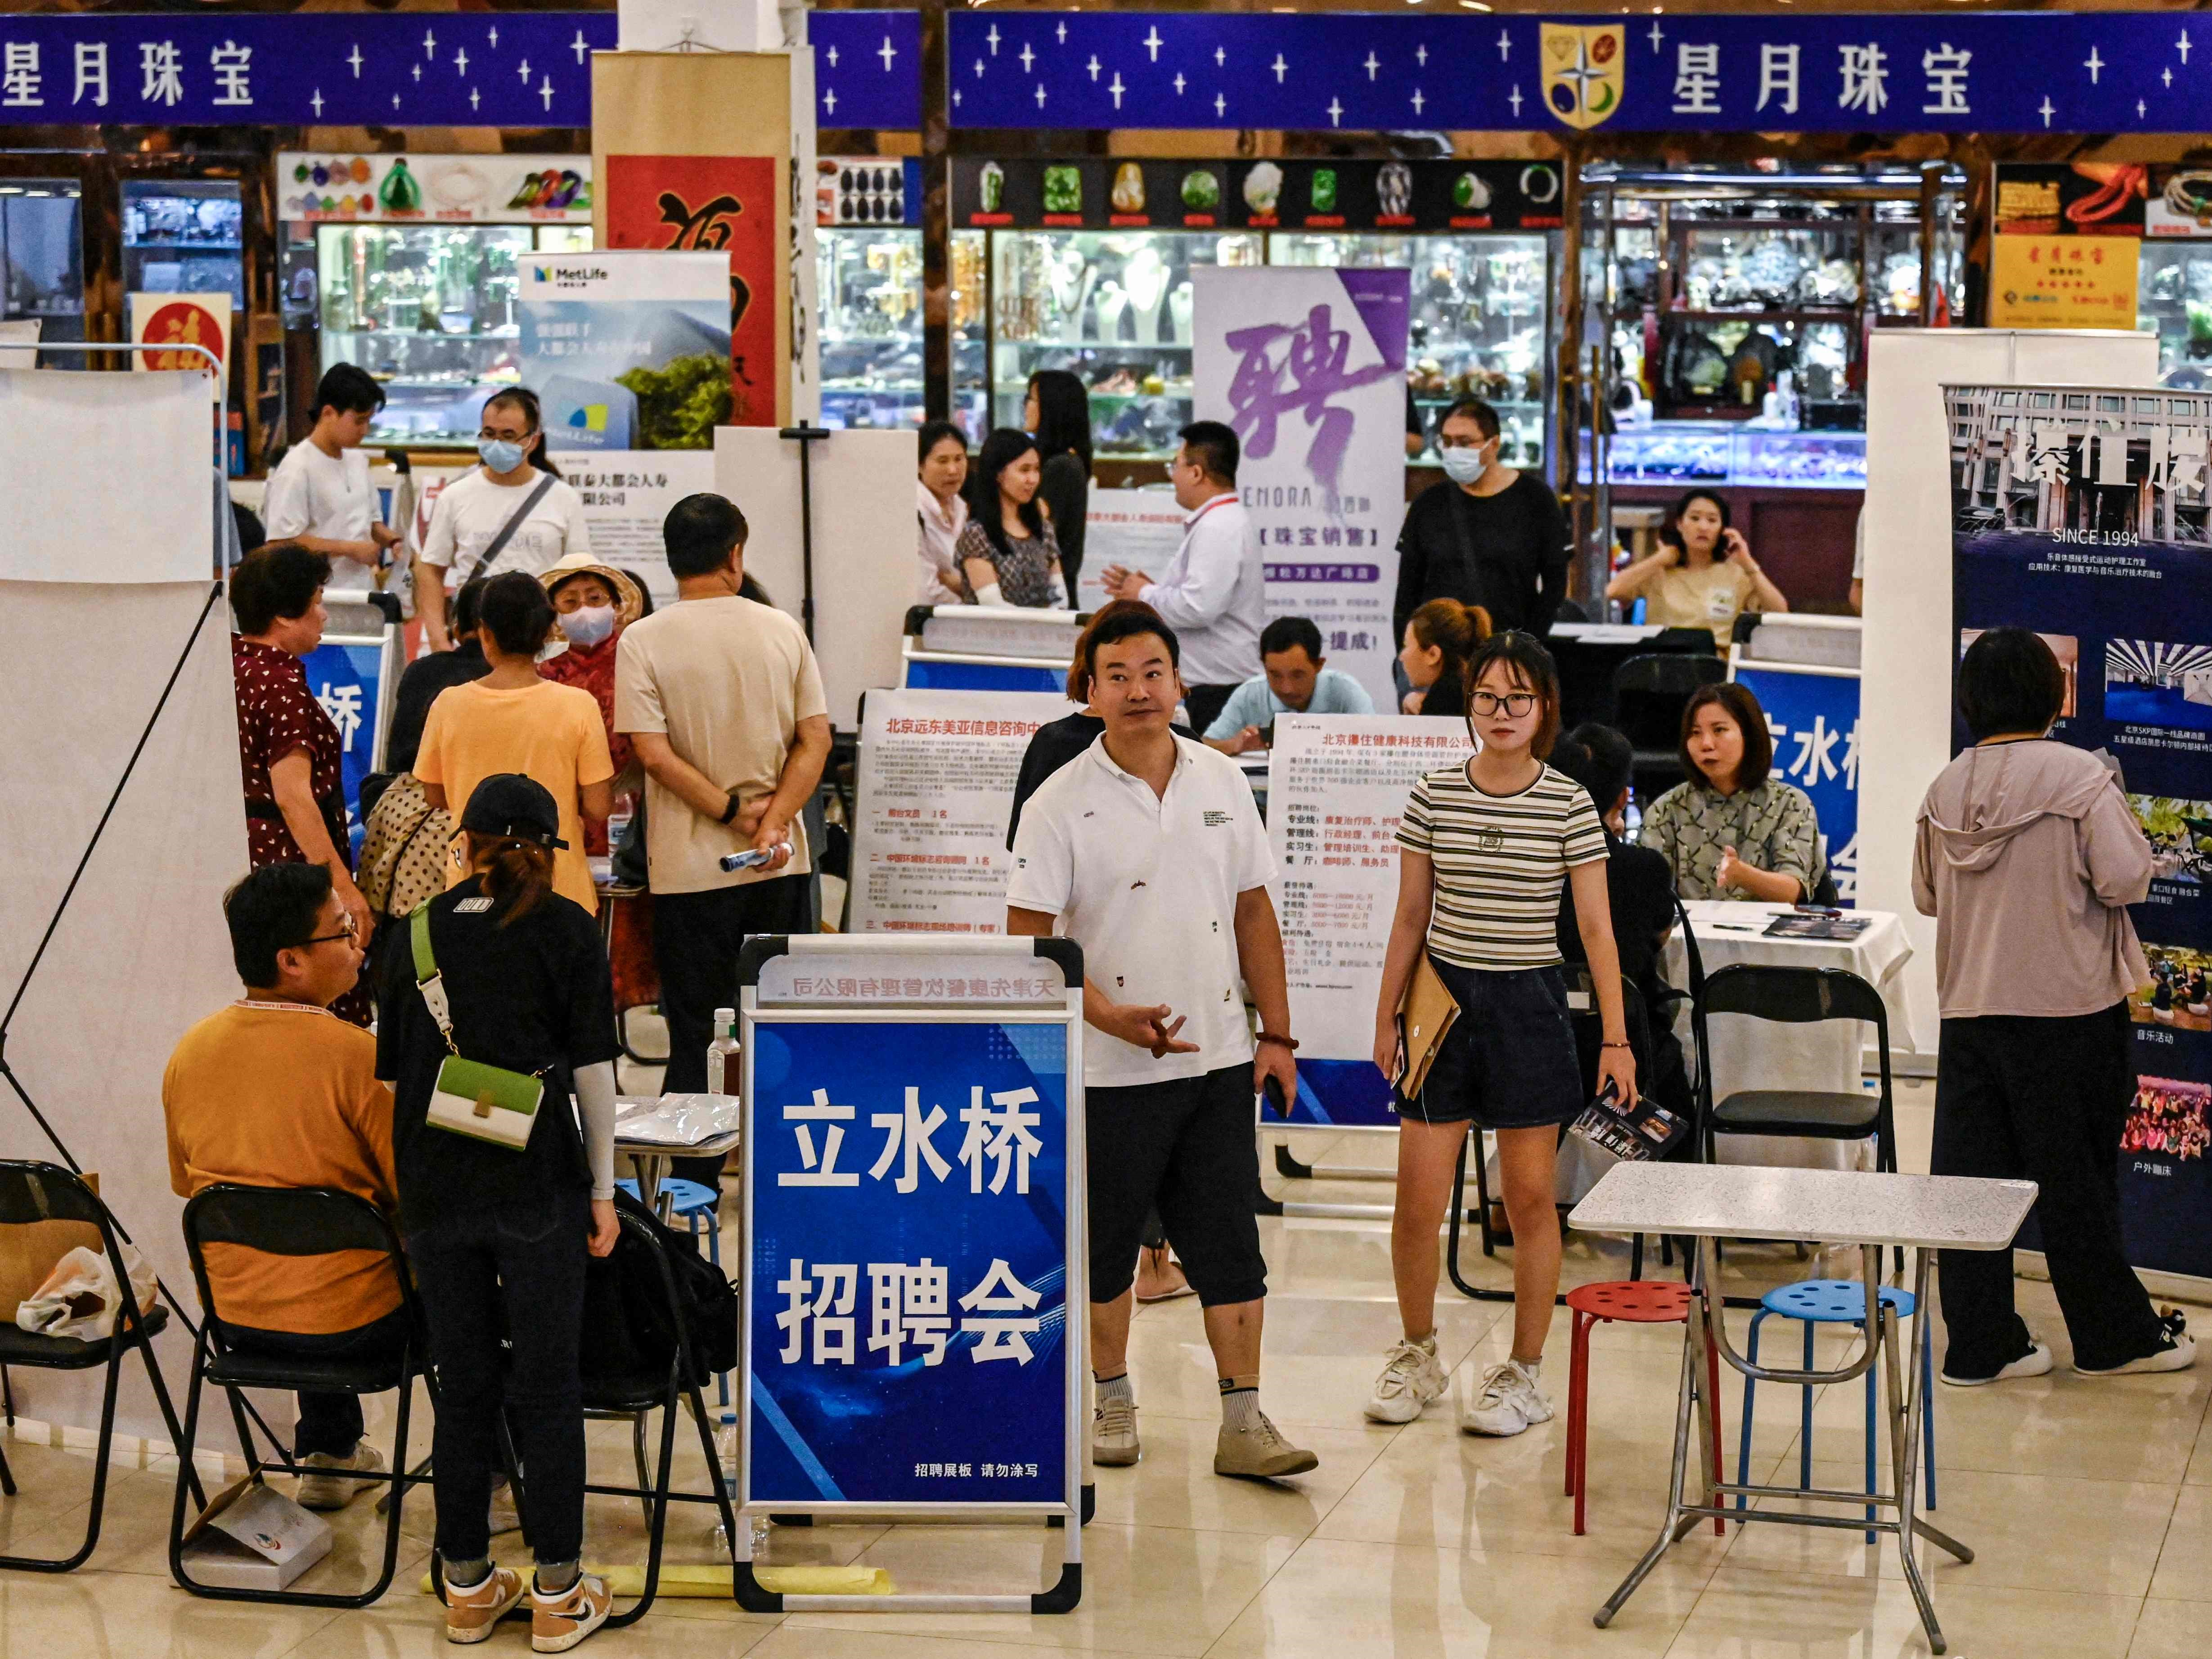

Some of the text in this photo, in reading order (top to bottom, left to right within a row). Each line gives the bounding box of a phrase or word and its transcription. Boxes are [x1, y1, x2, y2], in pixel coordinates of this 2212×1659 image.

[2, 40, 254, 107] 星月珠宝
[1672, 43, 1973, 115] 星月珠宝
[556, 268, 609, 280] MetLife
[1242, 487, 1312, 508] EMORA
[2052, 527, 2139, 547] SINCE 1994
[1287, 814, 1403, 827] 专业线：康复治疗师、护理
[2137, 1029, 2174, 1045] 音乐活动
[776, 1084, 1043, 1196] 立水桥
[2133, 1160, 2172, 1177] 户外蹦床
[776, 1257, 1043, 1367] 招聘会
[914, 1461, 1039, 1479] 招聘展板 请勿涂写
